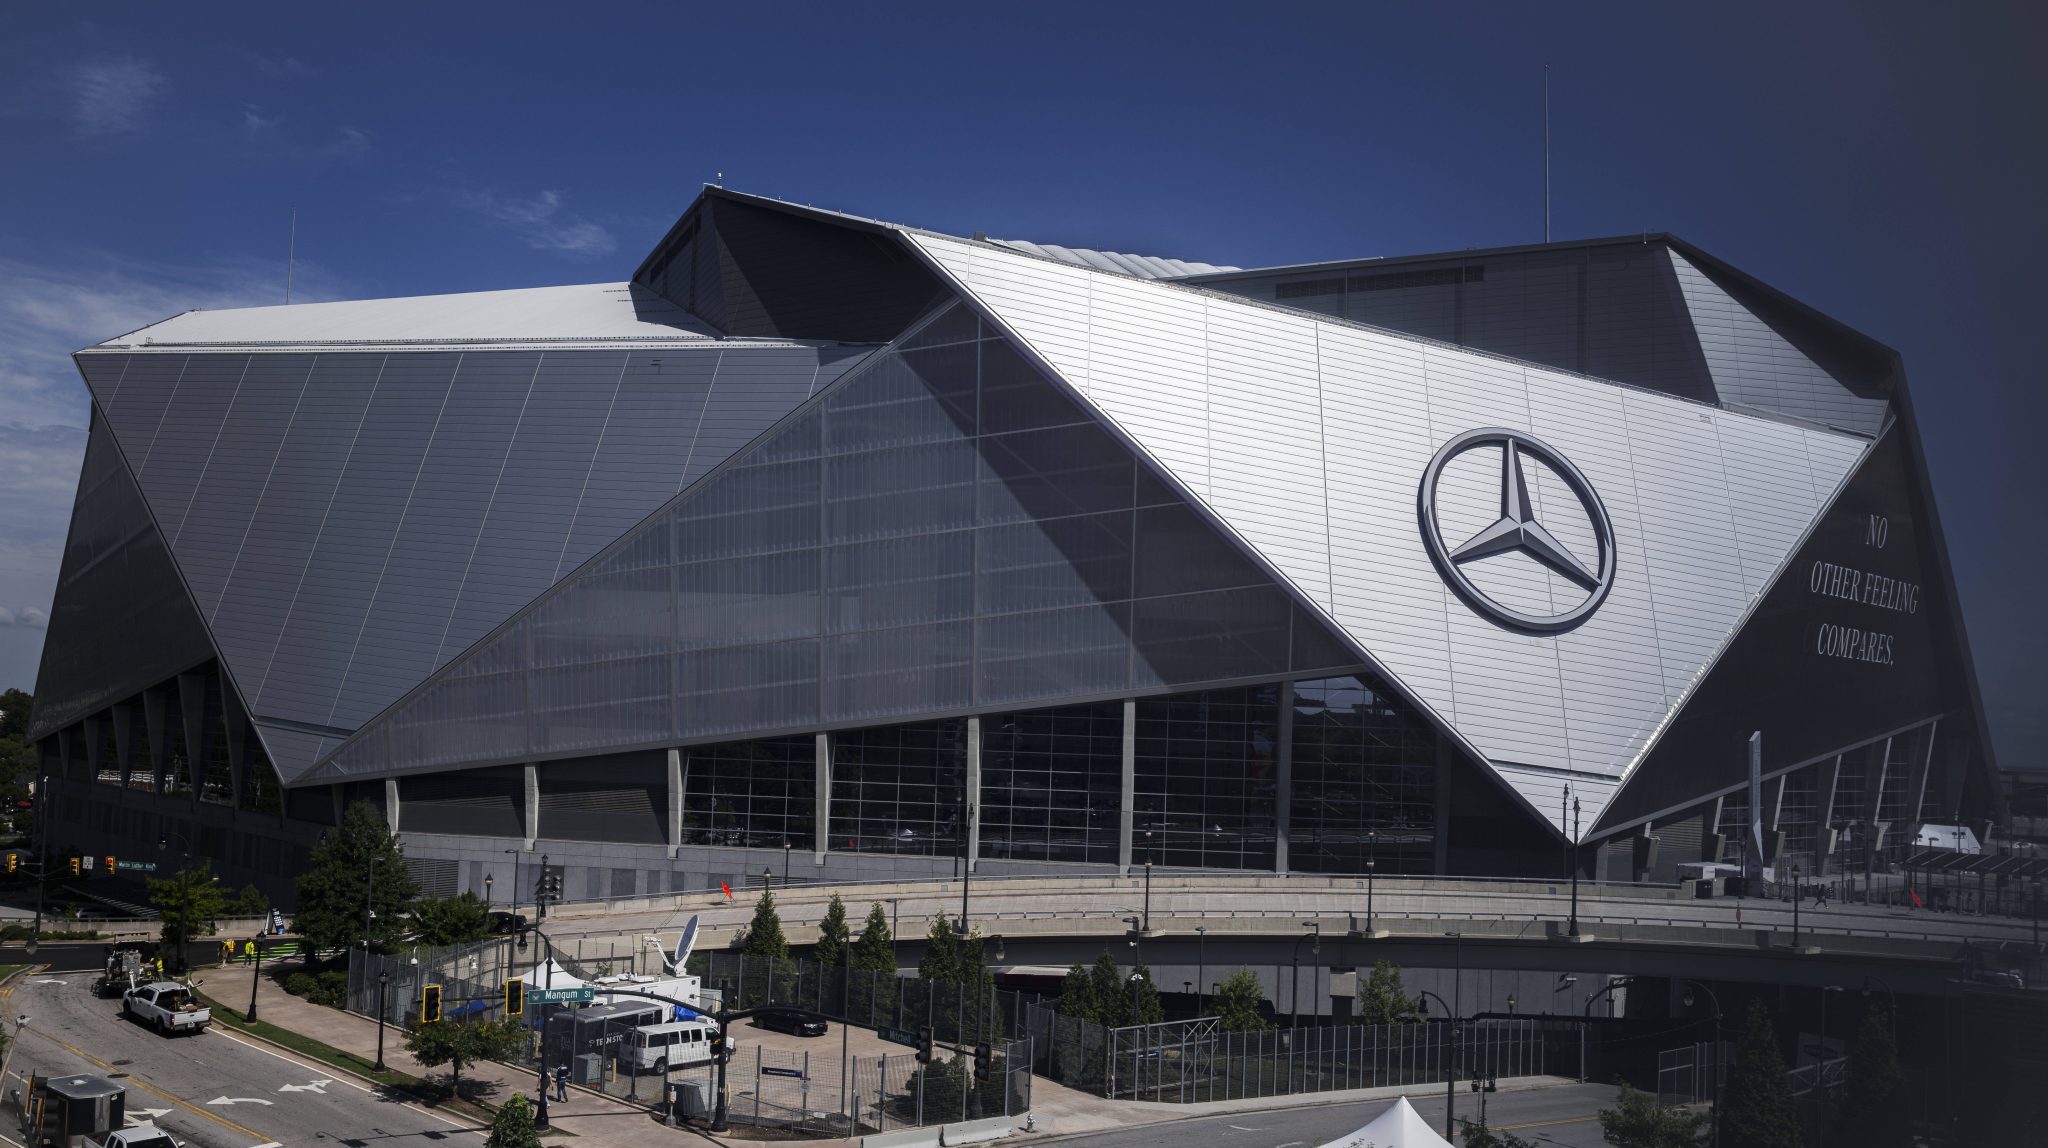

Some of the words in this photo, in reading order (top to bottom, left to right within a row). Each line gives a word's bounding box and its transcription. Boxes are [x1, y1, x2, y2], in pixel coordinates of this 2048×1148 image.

[1865, 513, 1888, 549] NO
[1810, 560, 1861, 602] OTHER
[1862, 572, 1919, 614] FEELING
[1817, 623, 1894, 666] COMPARES.
[545, 990, 578, 1002] Mangum
[584, 990, 591, 998] St
